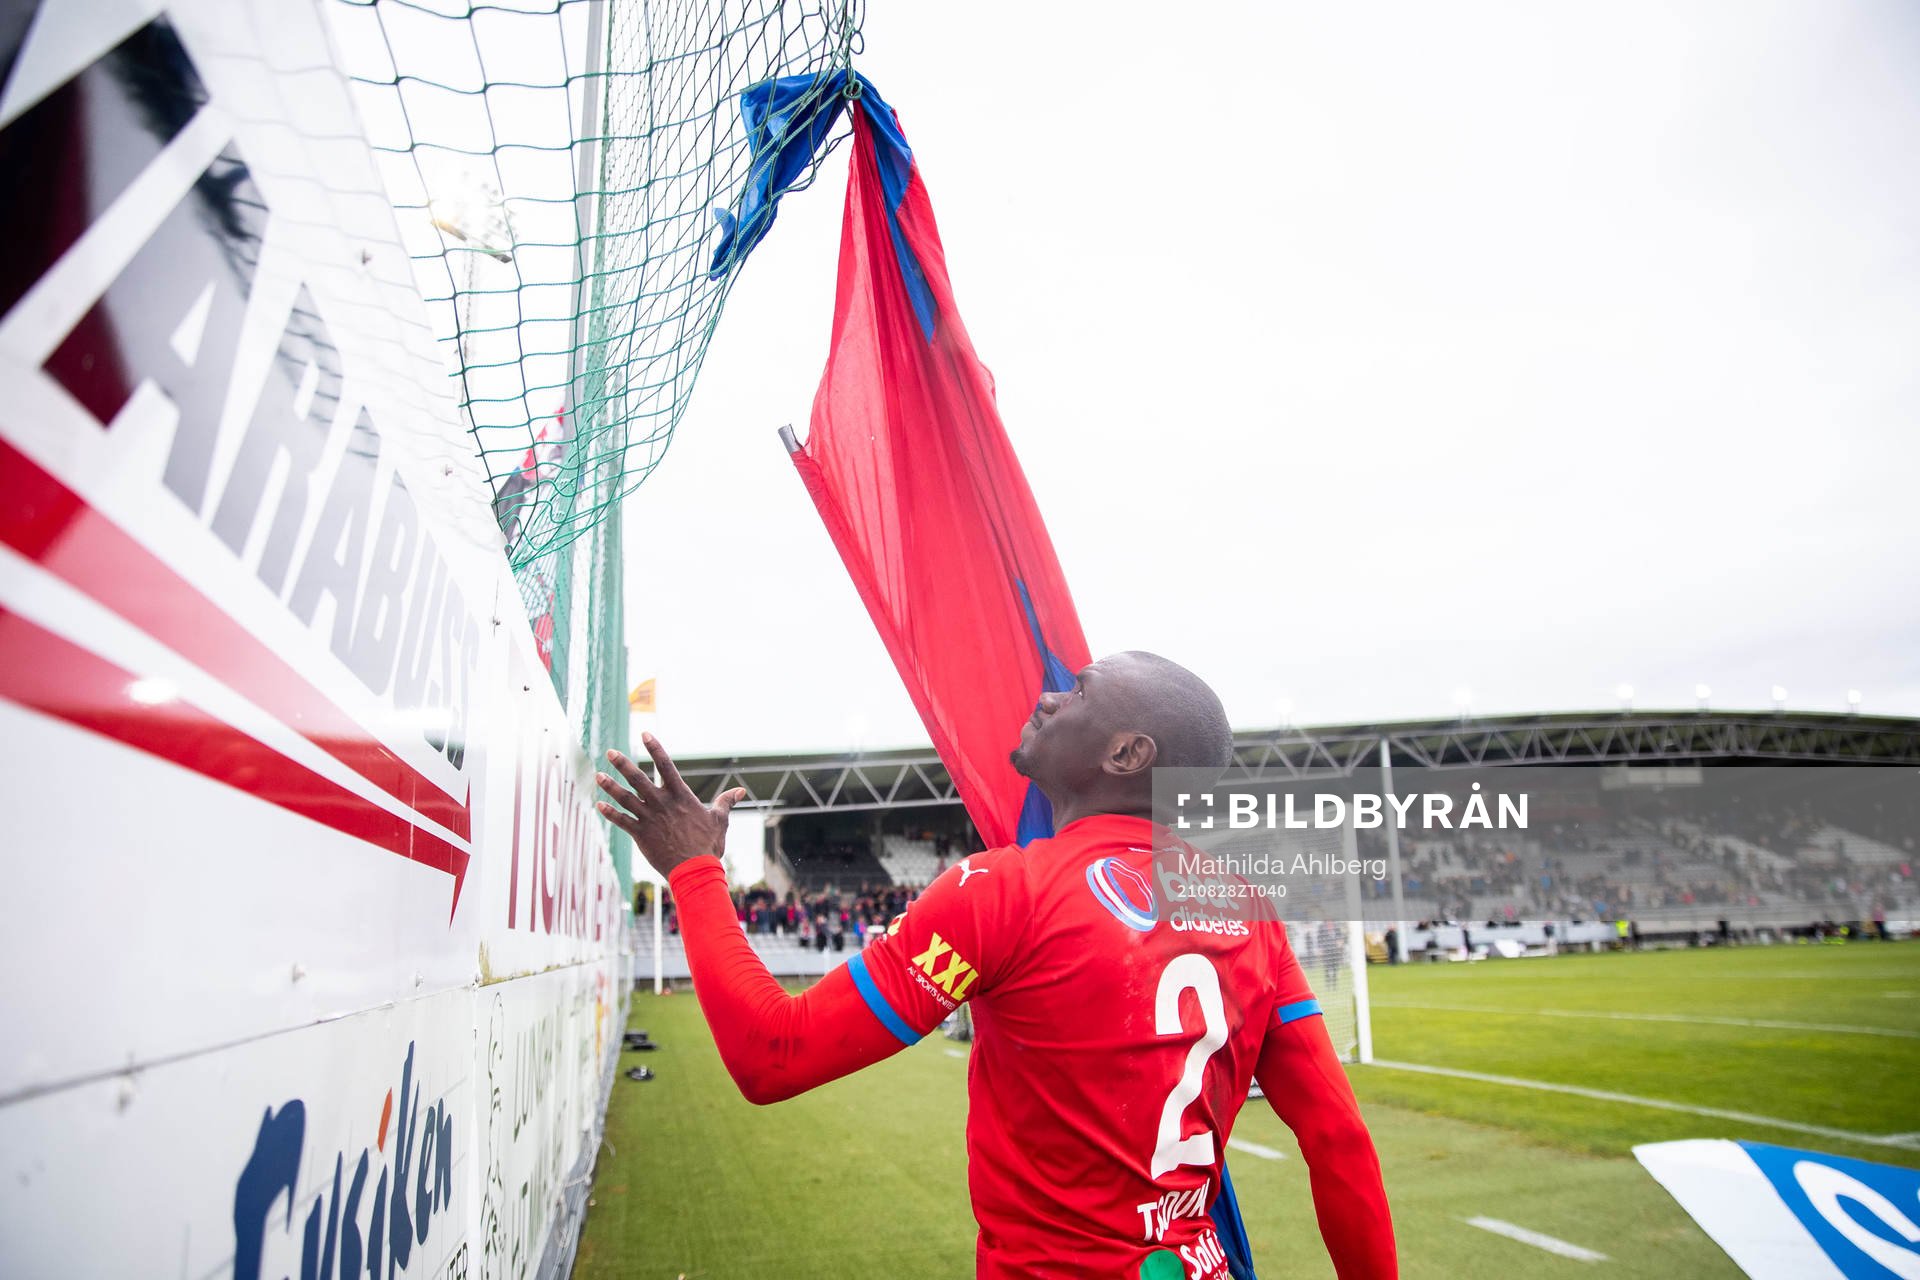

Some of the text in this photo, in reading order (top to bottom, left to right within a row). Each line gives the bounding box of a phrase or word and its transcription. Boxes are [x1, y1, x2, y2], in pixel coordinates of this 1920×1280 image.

[1170, 906, 1249, 936] diabetes
[911, 931, 979, 1001] XXL
[915, 974, 938, 997] SPORTS
[1151, 954, 1229, 1181] 2
